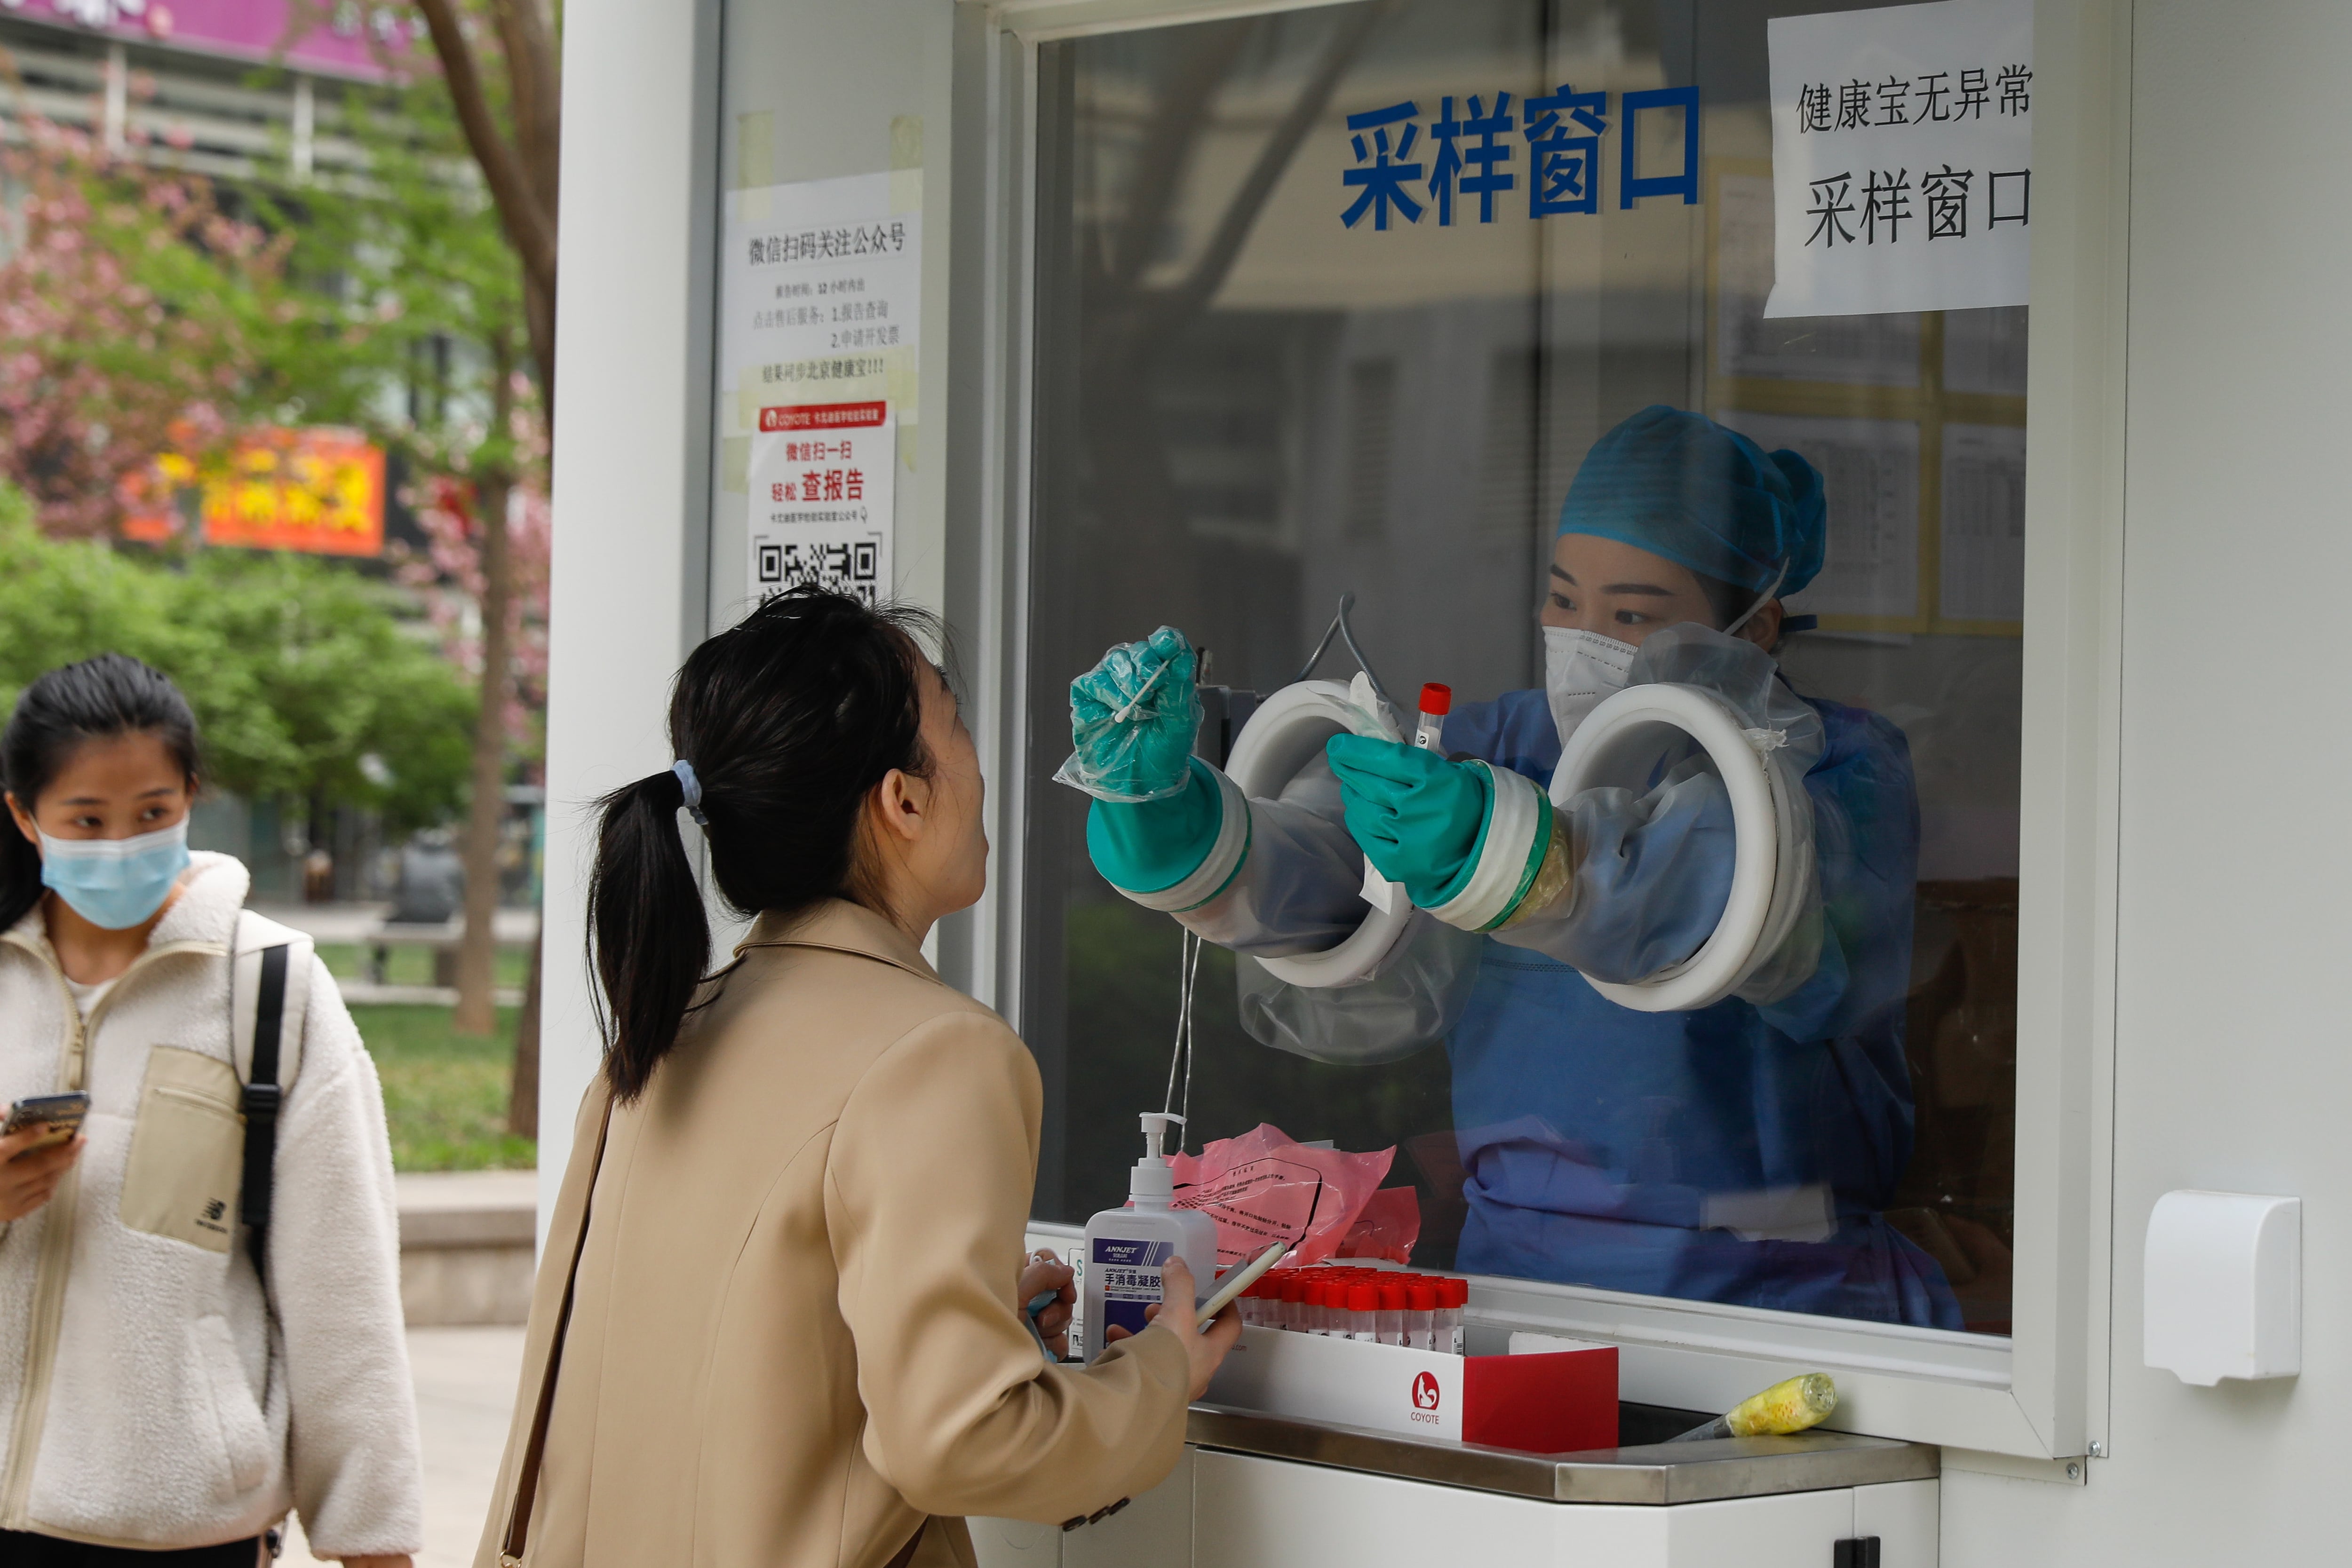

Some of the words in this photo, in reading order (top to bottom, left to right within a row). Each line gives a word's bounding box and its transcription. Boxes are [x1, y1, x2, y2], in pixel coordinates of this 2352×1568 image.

[1796, 63, 2033, 135] 健康宝无异常
[1340, 84, 1700, 231] 采样窗口
[1804, 163, 2032, 249] 采样窗口
[748, 222, 906, 266] 微信扫码关注公众号
[778, 412, 811, 426] COYOTE
[787, 440, 852, 461] 微信扫一扫
[772, 483, 796, 502] 轻松
[802, 467, 864, 501] 查报告
[1105, 1245, 1137, 1254] ANNJET
[1104, 1273, 1161, 1288] 手消毒凝胶
[1411, 1411, 1439, 1425] COYOTE
